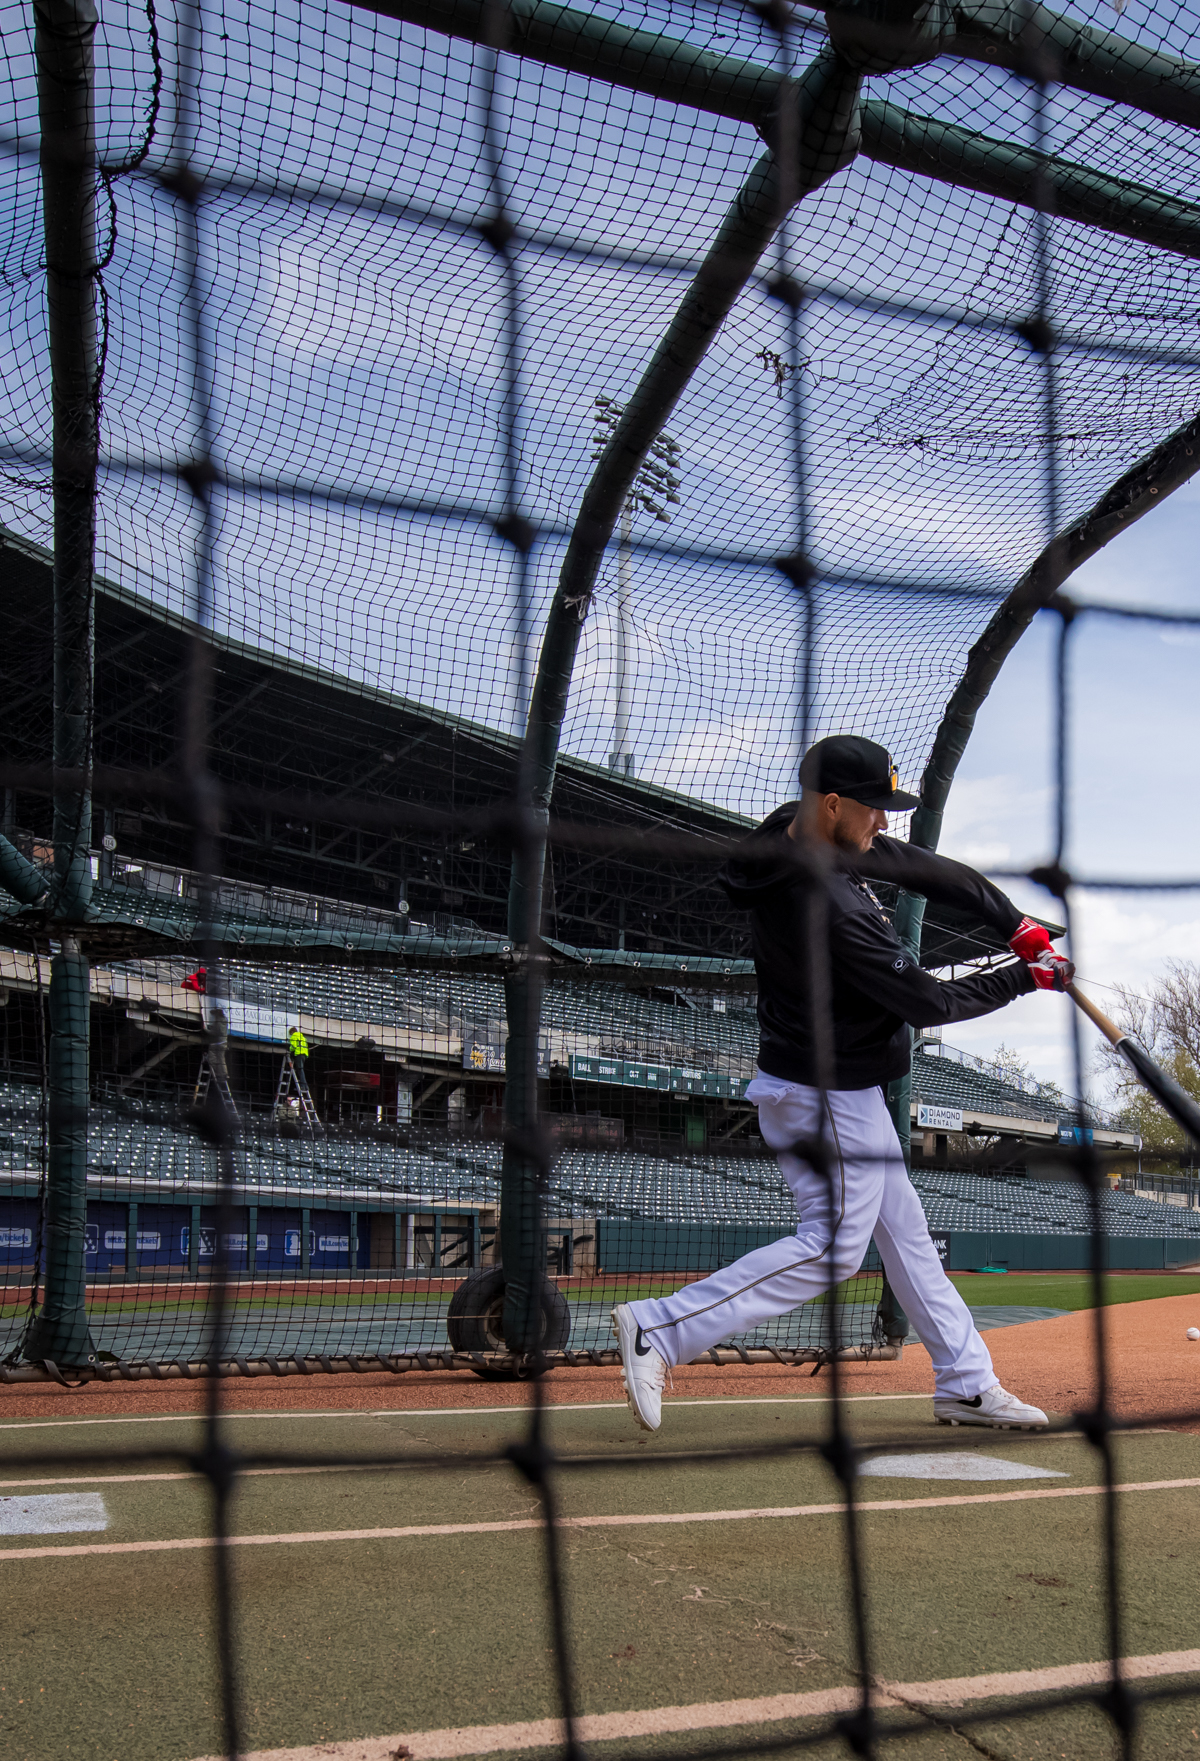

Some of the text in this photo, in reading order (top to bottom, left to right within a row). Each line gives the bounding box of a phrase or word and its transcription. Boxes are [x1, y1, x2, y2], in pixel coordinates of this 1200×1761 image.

[577, 1062, 592, 1073] BALL
[598, 1065, 617, 1075] STRIKE
[928, 1107, 961, 1120] DIAMOND
[928, 1117, 953, 1128] RENTAL
[932, 1239, 947, 1250] ANK
